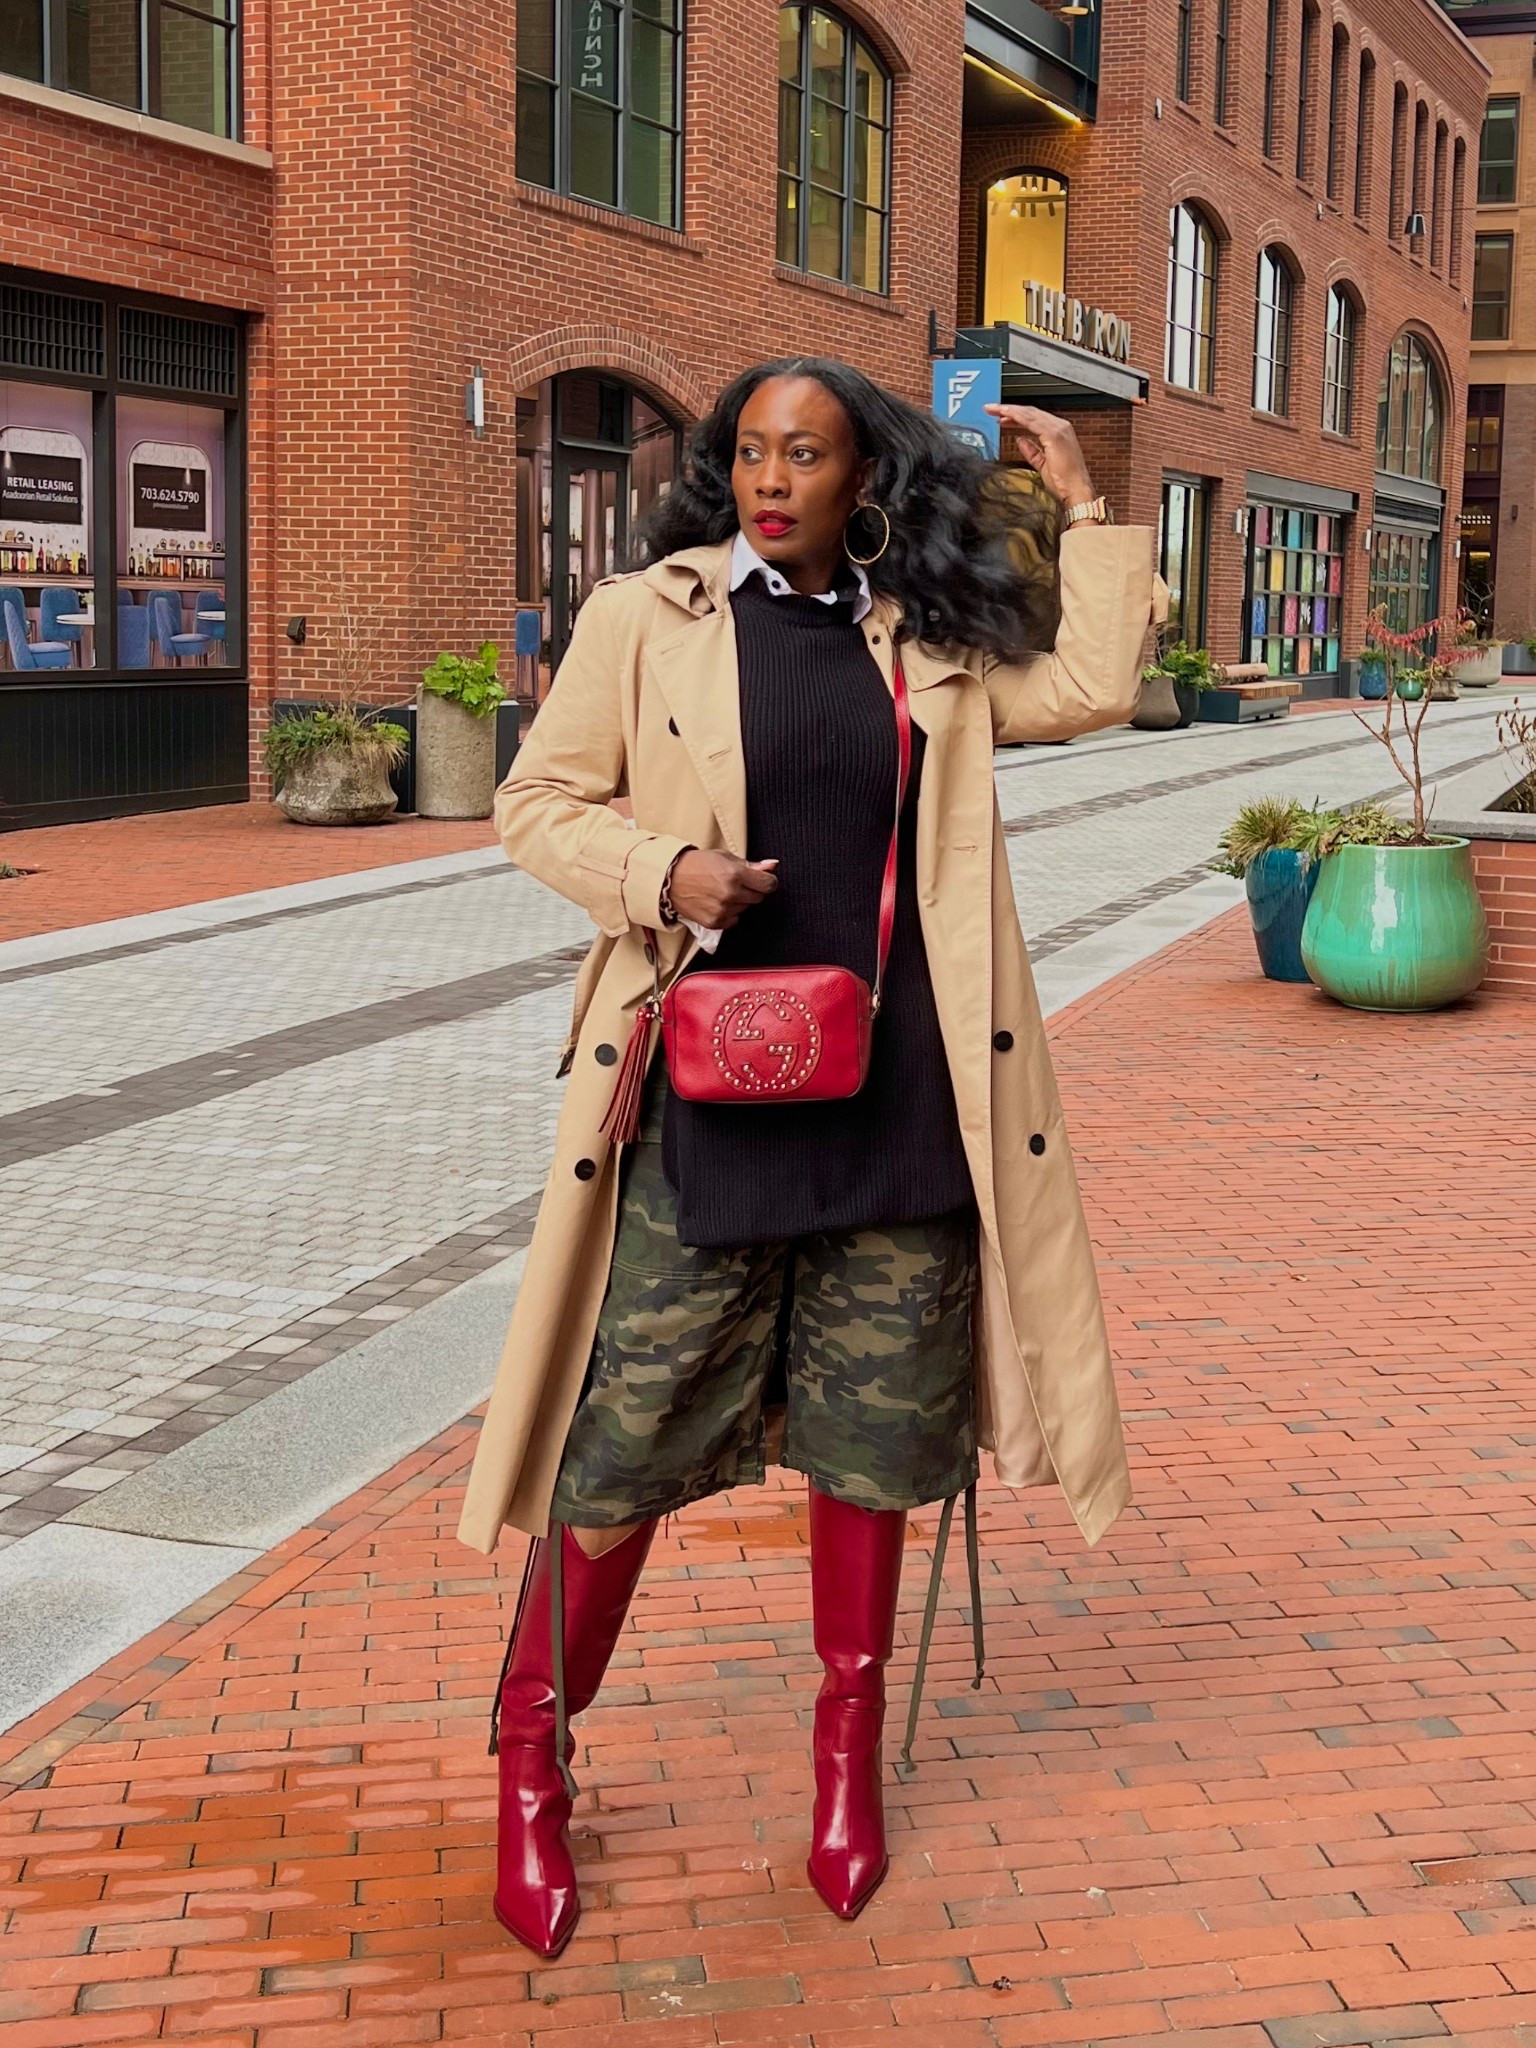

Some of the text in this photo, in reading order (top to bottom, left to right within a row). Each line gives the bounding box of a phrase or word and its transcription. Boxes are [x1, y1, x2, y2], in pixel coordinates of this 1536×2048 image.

[1023, 280, 1132, 361] THE BYRON
[7, 476, 74, 492] RETAIL LEASING
[36, 491, 52, 502] Retail
[52, 493, 79, 503] Solutions
[140, 487, 200, 503] 703.624.5790
